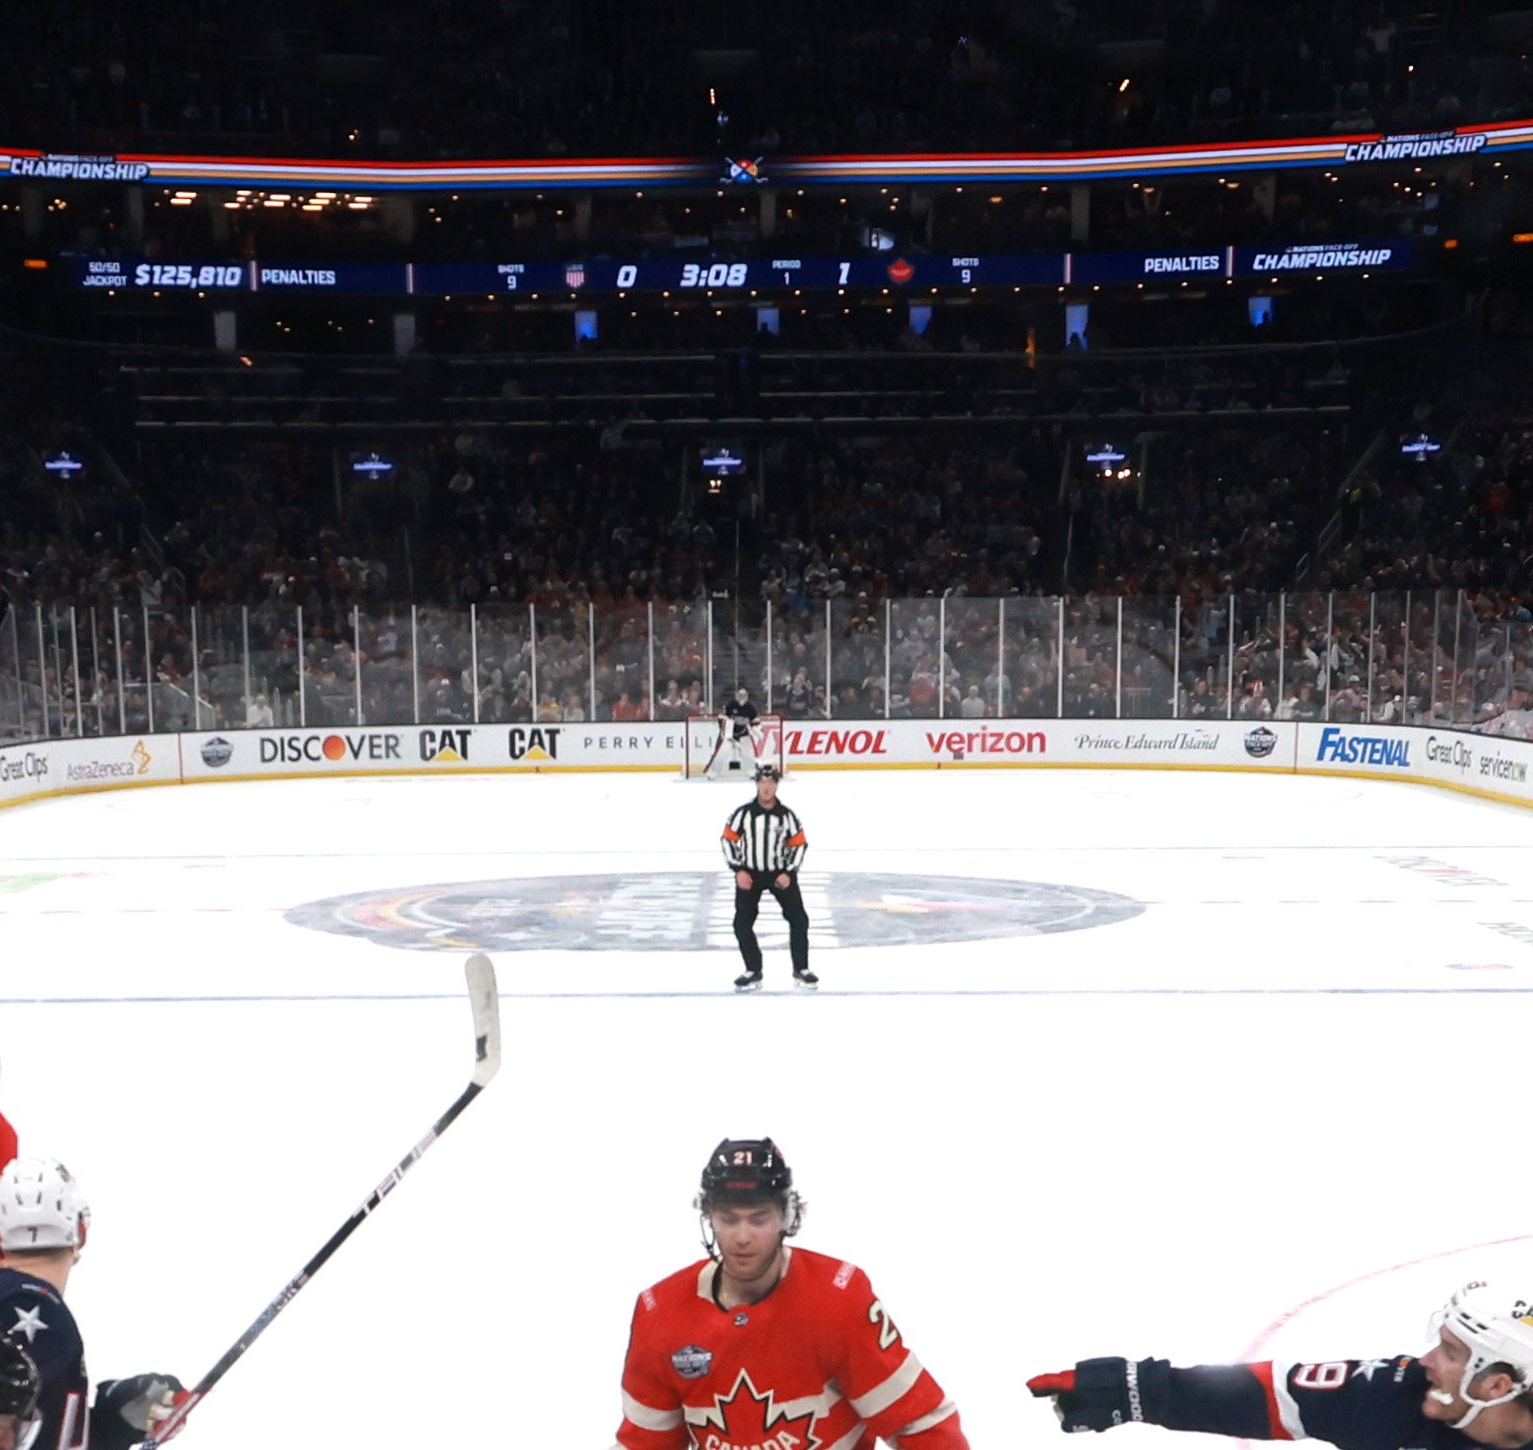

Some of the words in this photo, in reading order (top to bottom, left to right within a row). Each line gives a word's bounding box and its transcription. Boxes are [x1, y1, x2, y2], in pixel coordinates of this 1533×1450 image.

[1345, 134, 1486, 162] CHAMPIONSHIP
[11, 158, 148, 181] CHAMPIONSHIP
[89, 262, 121, 273] 50/50
[952, 257, 980, 267] SHOTS
[1144, 256, 1219, 273] PENALTIES
[1252, 249, 1392, 270] CHAMPIONSHIP
[83, 275, 128, 287] JACKPOT
[135, 264, 241, 289] $125,810
[261, 269, 336, 285] PENALTIES
[507, 275, 517, 290] 9
[617, 265, 638, 288] 0
[680, 263, 748, 287] 3:08
[783, 272, 791, 286] 1
[838, 262, 852, 286] 1
[961, 269, 971, 284] 9
[259, 733, 402, 764] DISCOVER
[419, 729, 472, 762] CAT
[509, 728, 561, 761] CAT
[584, 737, 654, 750] PERRY
[926, 725, 1047, 754] verizon
[1077, 733, 1123, 750] Prince
[1124, 733, 1179, 750] Edward
[1180, 732, 1220, 751] Island
[1317, 727, 1411, 767] FASTENAL
[1425, 736, 1453, 765] Great
[1453, 740, 1472, 769] Clips
[0, 755, 24, 783] Great
[24, 752, 49, 783] Clips
[67, 759, 135, 782] AstraZeneca
[1480, 750, 1527, 782] servicenow
[732, 1150, 753, 1166] 21
[26, 1227, 39, 1243] 7
